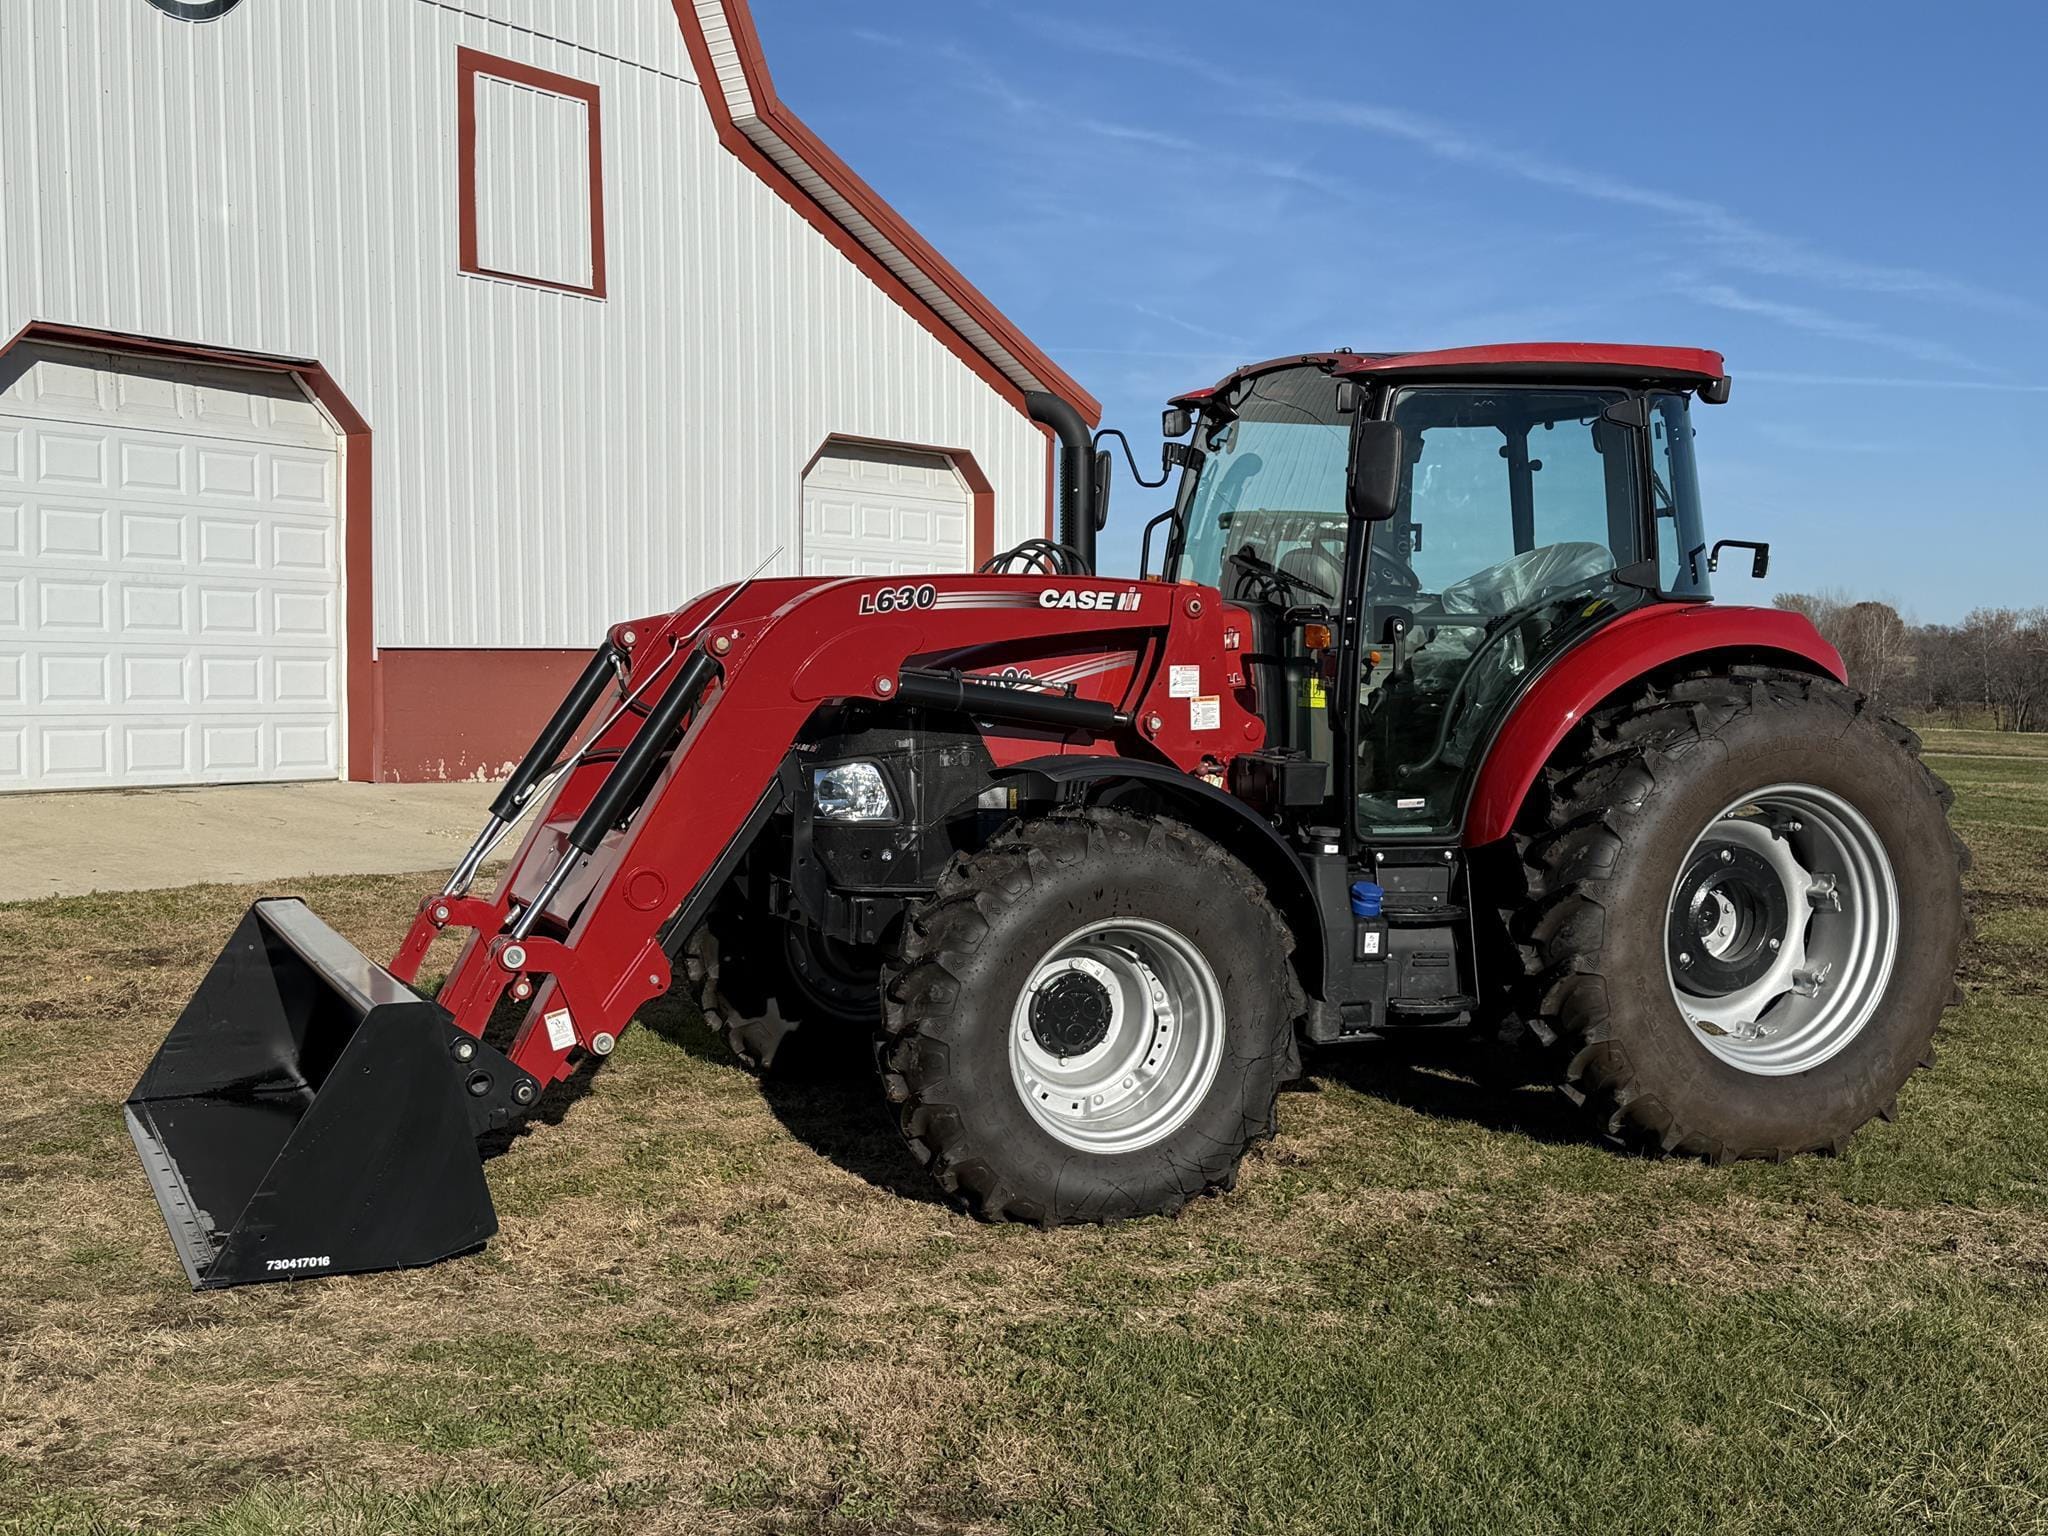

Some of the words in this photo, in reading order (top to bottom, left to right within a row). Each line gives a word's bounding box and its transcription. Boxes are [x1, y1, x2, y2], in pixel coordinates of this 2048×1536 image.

[859, 583, 937, 615] L630
[1039, 588, 1116, 610] CASE
[266, 1255, 331, 1271] 730417016
